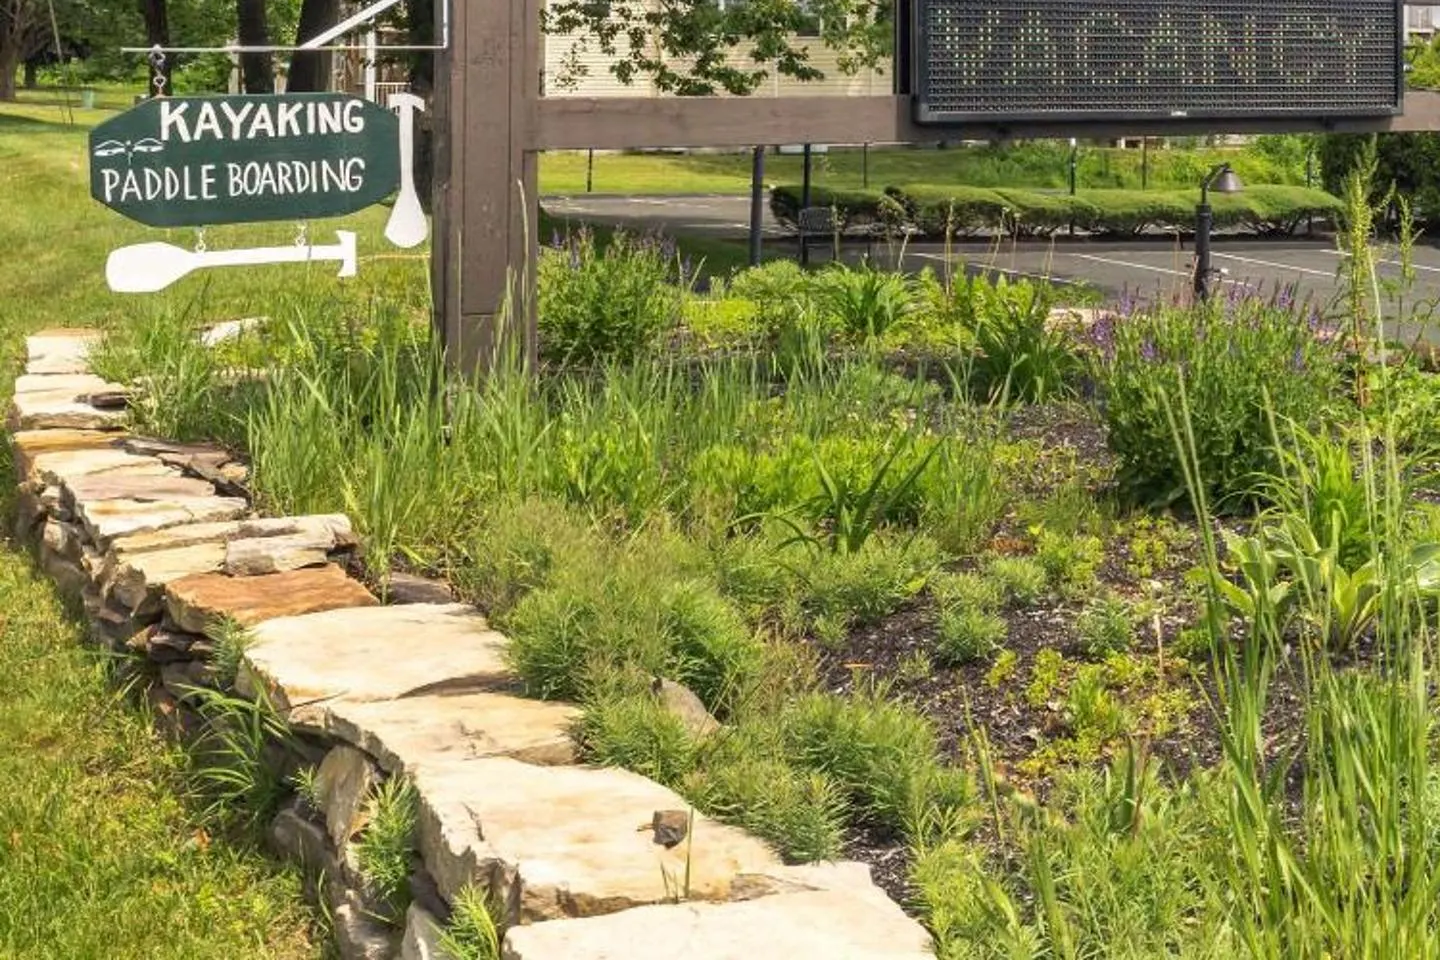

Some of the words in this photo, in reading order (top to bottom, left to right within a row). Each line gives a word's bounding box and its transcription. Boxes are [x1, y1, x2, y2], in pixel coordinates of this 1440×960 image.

[937, 8, 1377, 86] VACANCY
[160, 99, 365, 143] KAYAKING
[101, 164, 216, 202] PADDLE
[227, 157, 366, 197] BOARDING
